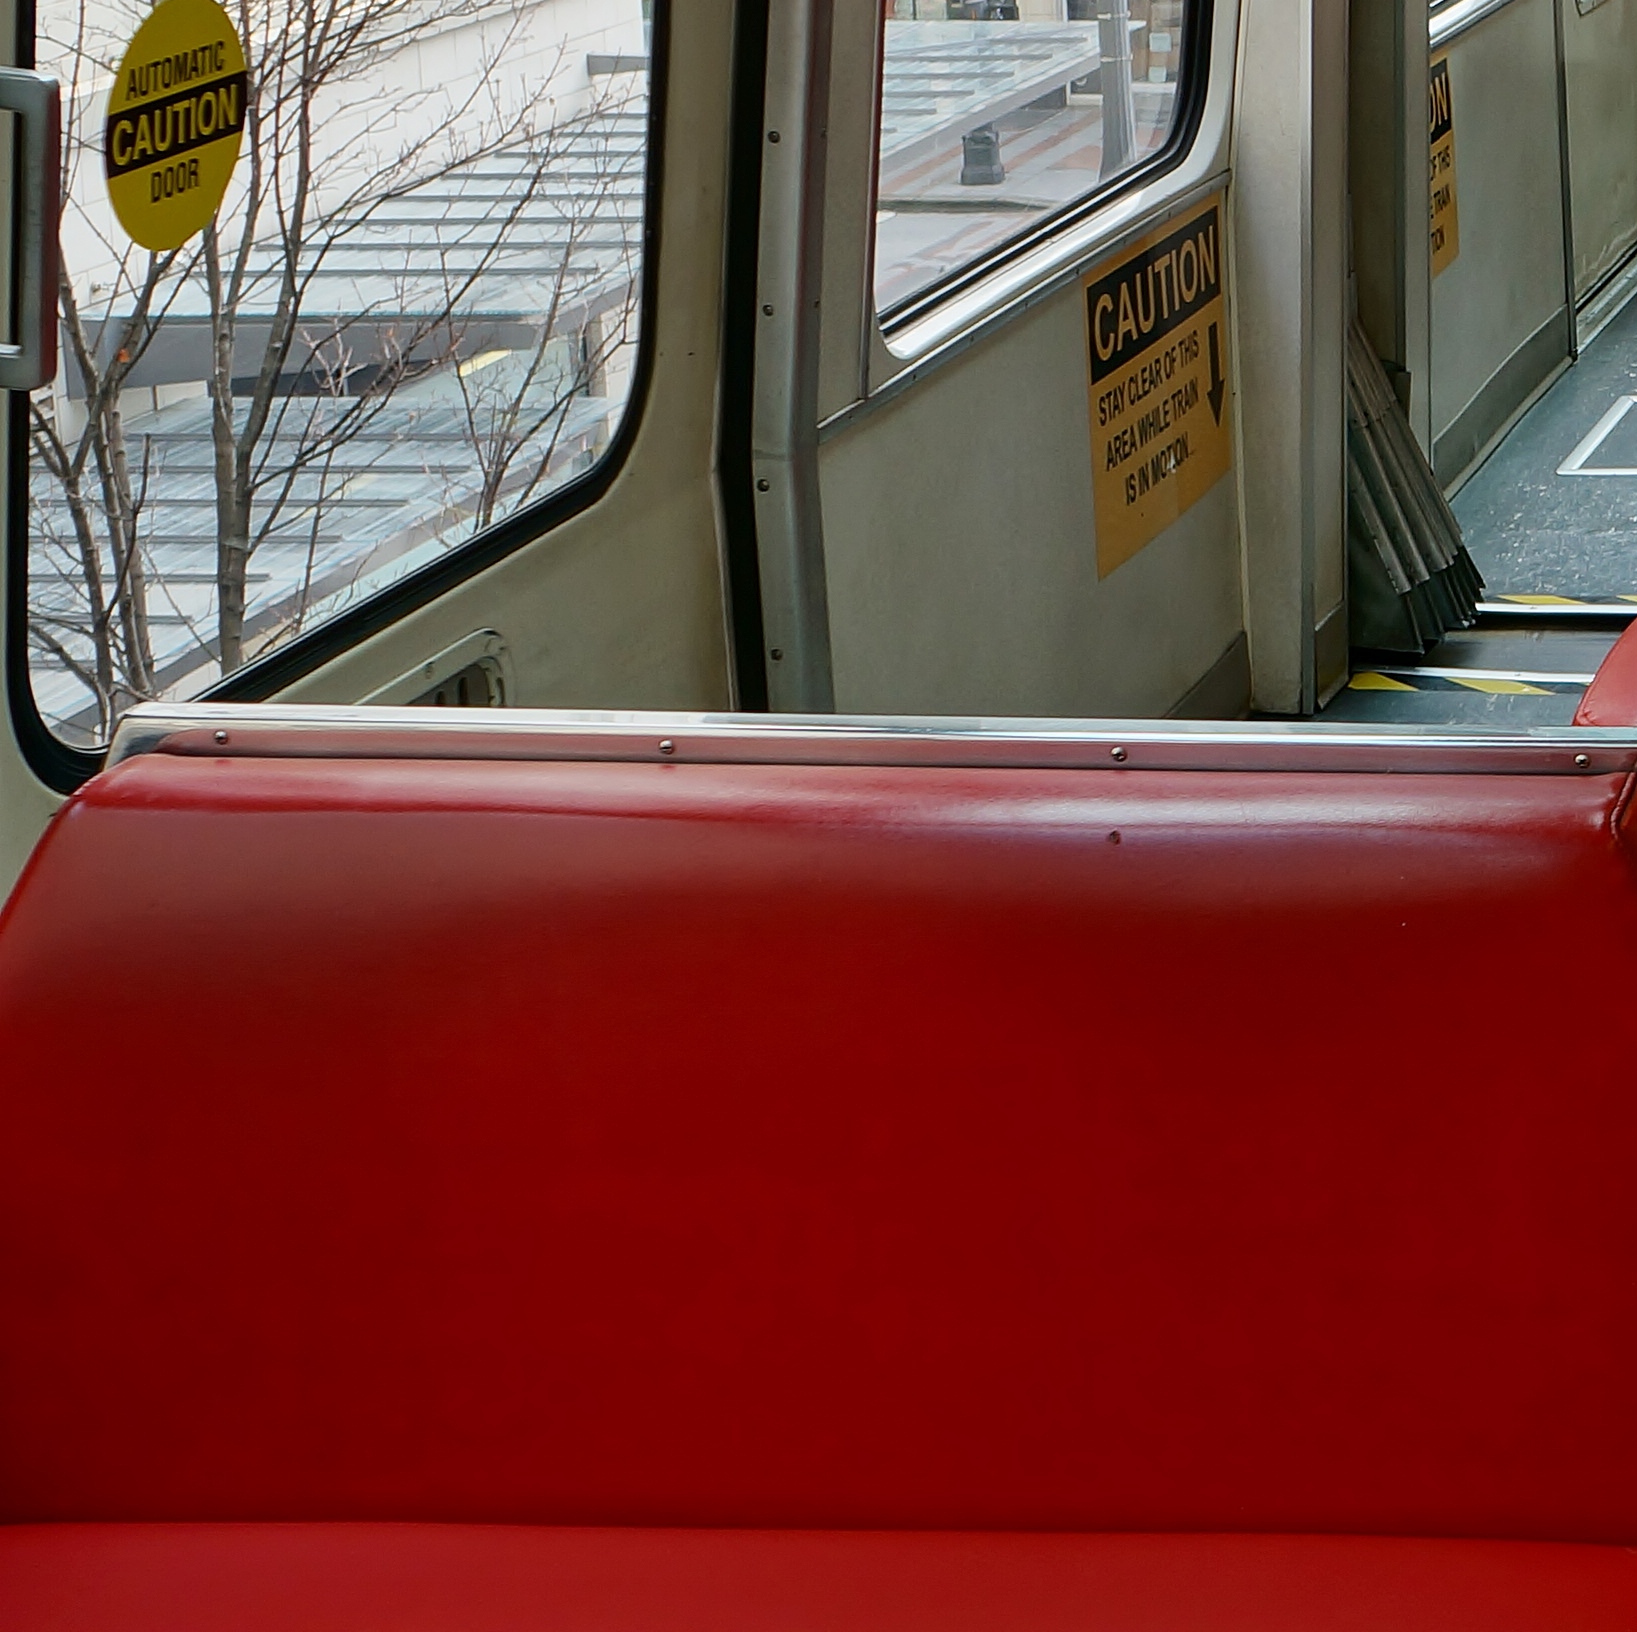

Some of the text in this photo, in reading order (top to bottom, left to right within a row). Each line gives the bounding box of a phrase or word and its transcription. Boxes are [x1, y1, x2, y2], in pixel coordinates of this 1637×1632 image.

[125, 40, 225, 101] AUTOMATIC
[111, 83, 238, 166] CAUTION
[150, 157, 199, 204] DOOR
[1094, 224, 1216, 361] CAUTION
[1098, 330, 1199, 427] STAY CLEAR OF THIS
[1106, 377, 1199, 472] AREA WHILE TRAIN
[1125, 472, 1137, 506] IS
[1138, 461, 1150, 497] IN
